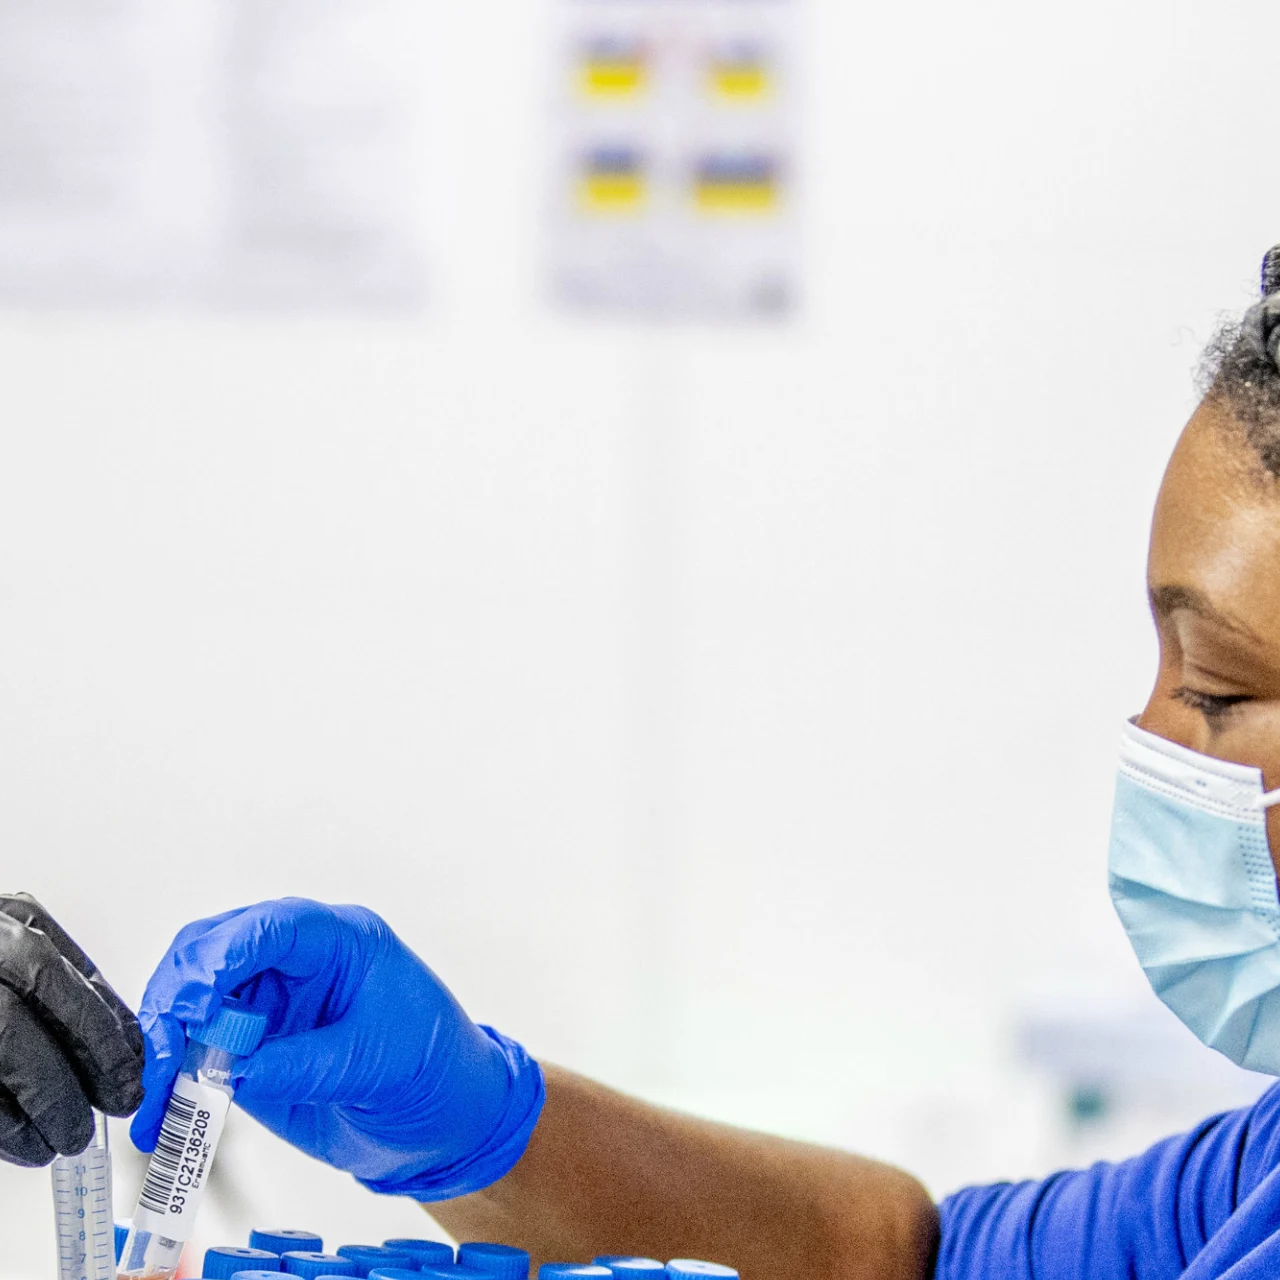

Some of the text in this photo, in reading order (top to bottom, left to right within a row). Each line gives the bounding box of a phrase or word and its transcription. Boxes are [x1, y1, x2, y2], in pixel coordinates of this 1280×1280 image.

[169, 1109, 211, 1215] 931C2136208
[74, 1186, 88, 1196] 10
[77, 1208, 85, 1219] 9
[78, 1230, 86, 1241] 8
[80, 1253, 87, 1264] 7
